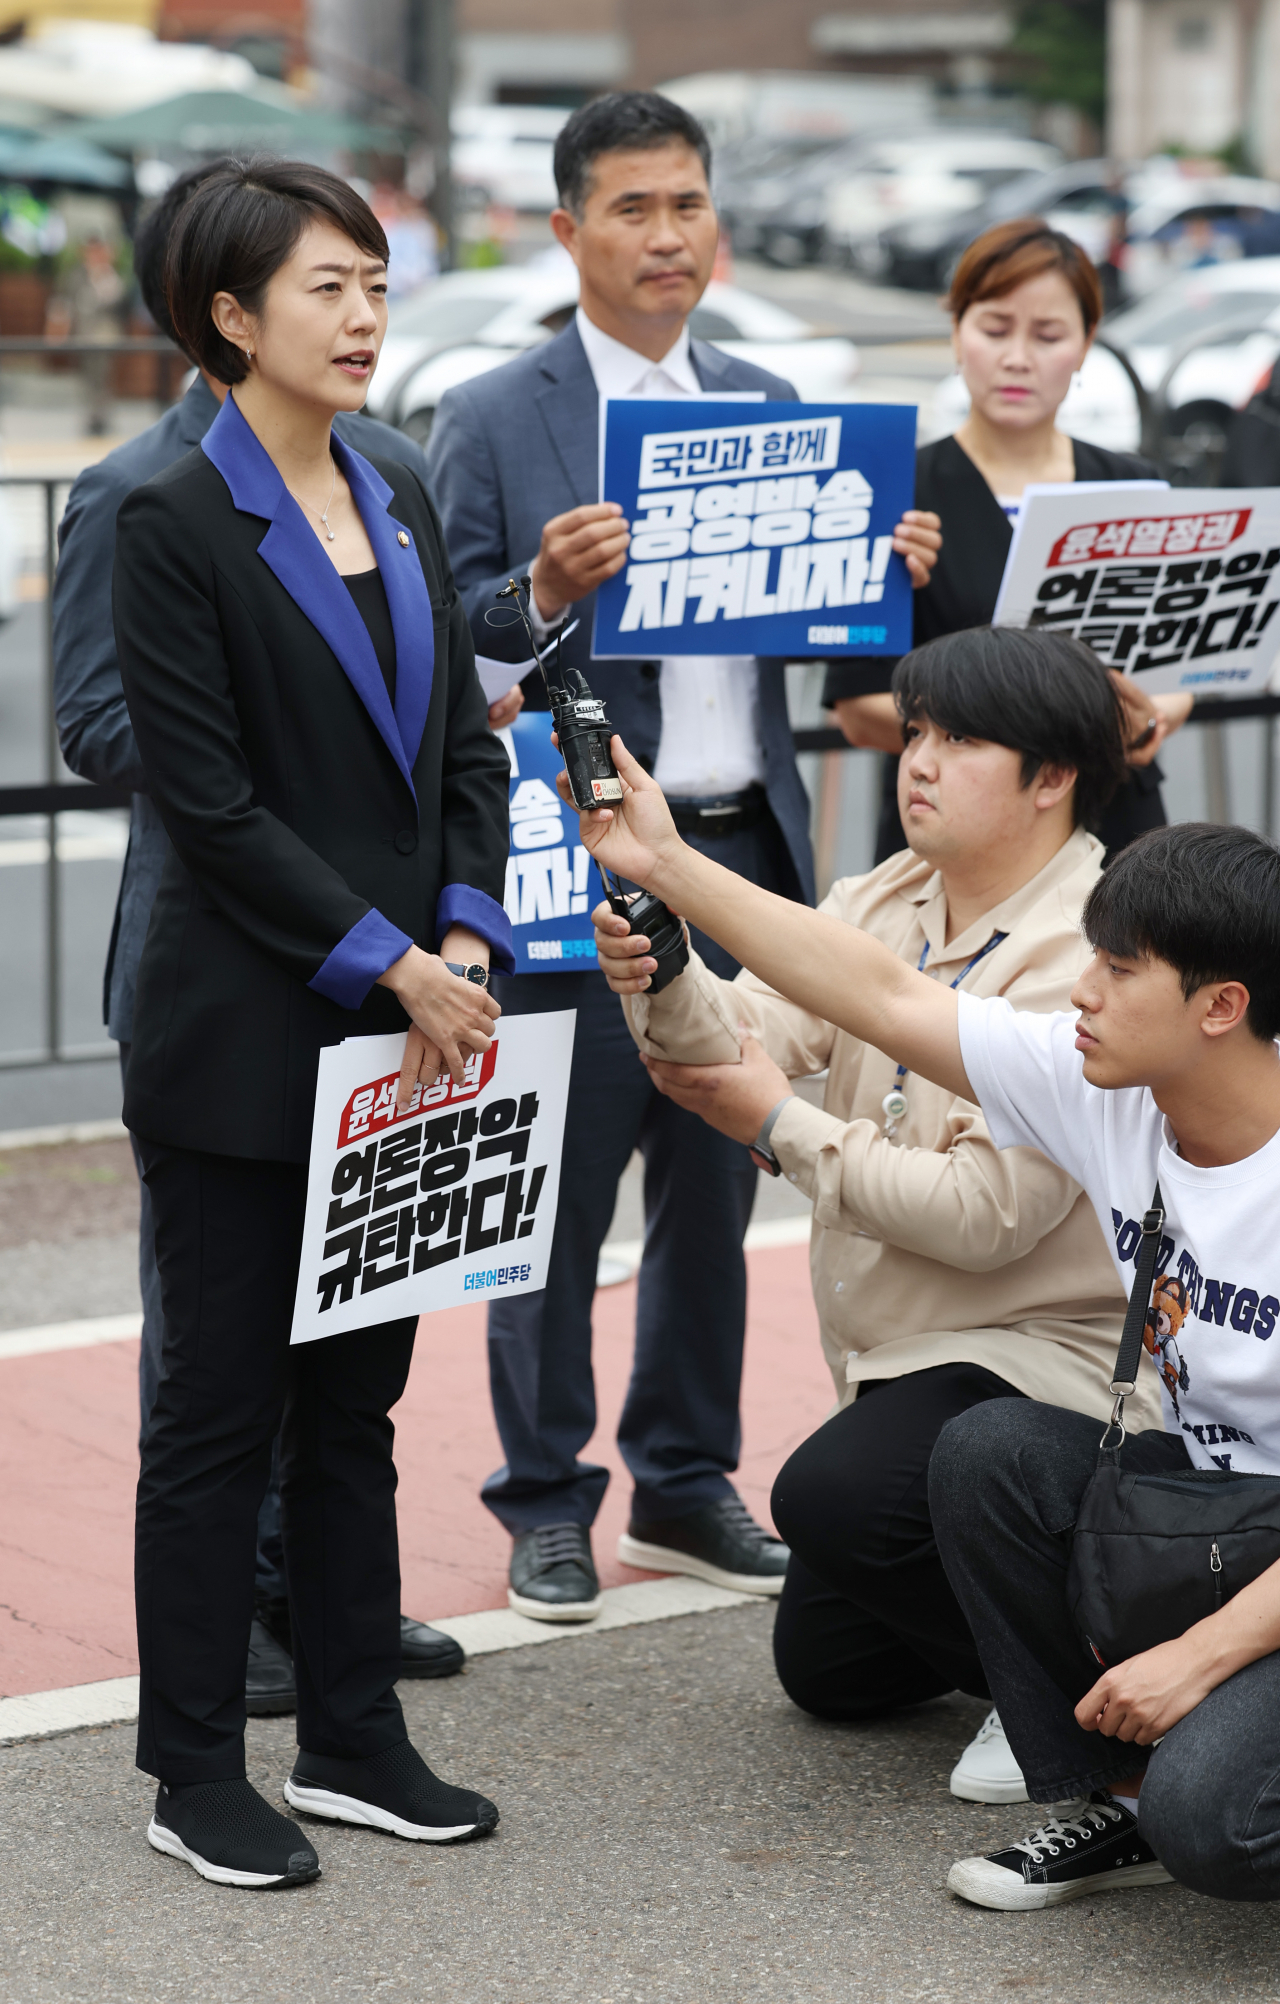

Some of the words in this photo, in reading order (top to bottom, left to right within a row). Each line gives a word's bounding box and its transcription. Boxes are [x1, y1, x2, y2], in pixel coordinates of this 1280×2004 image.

[651, 434, 752, 480] 국민과
[762, 426, 828, 468] 함께
[628, 469, 874, 561] 공영방송
[1058, 512, 1240, 562] 윤석열정권
[618, 535, 894, 632] 지켜내자!
[1028, 547, 1280, 626] 언론장악
[325, 1090, 540, 1234] 언론장악
[316, 1163, 548, 1315] 규탄한다!
[463, 1263, 532, 1292] 더불어민주당
